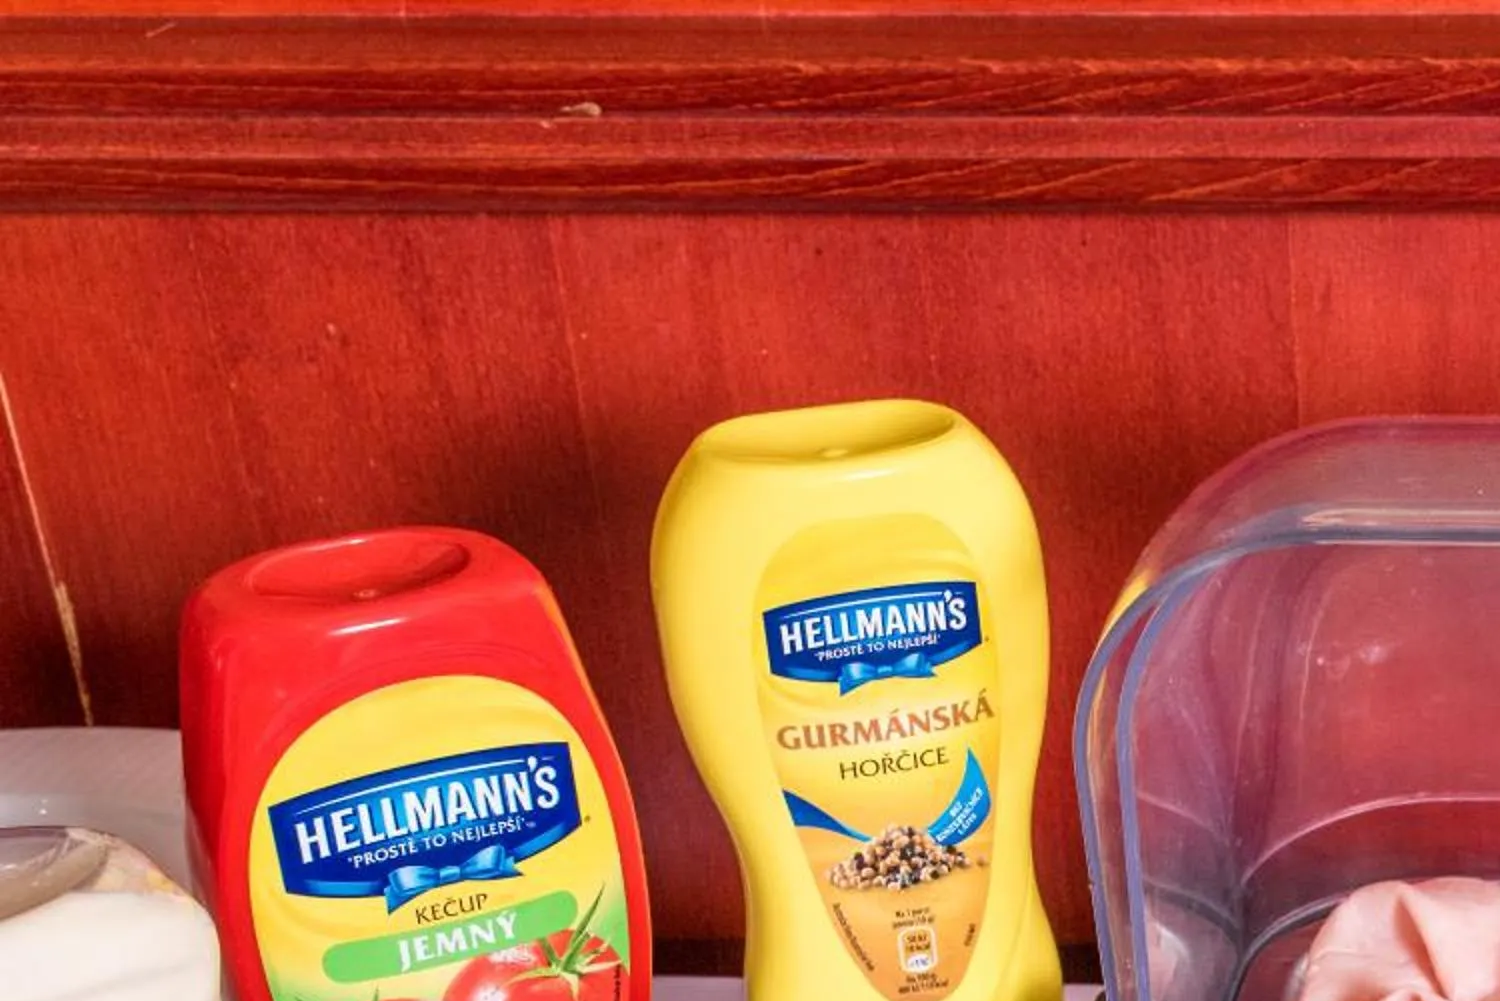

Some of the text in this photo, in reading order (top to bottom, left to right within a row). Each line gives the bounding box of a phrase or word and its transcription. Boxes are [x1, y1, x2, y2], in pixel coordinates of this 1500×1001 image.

[780, 589, 968, 655] HELLMANN'S
[868, 641, 884, 653] TO
[776, 688, 996, 751] GURMÁNSKÁ
[839, 746, 950, 781] HOŘČICE
[294, 756, 561, 864] HELLMANN'S
[422, 833, 447, 850] TO
[415, 892, 488, 925] KEČUP
[397, 909, 517, 973] JEMNÝ
